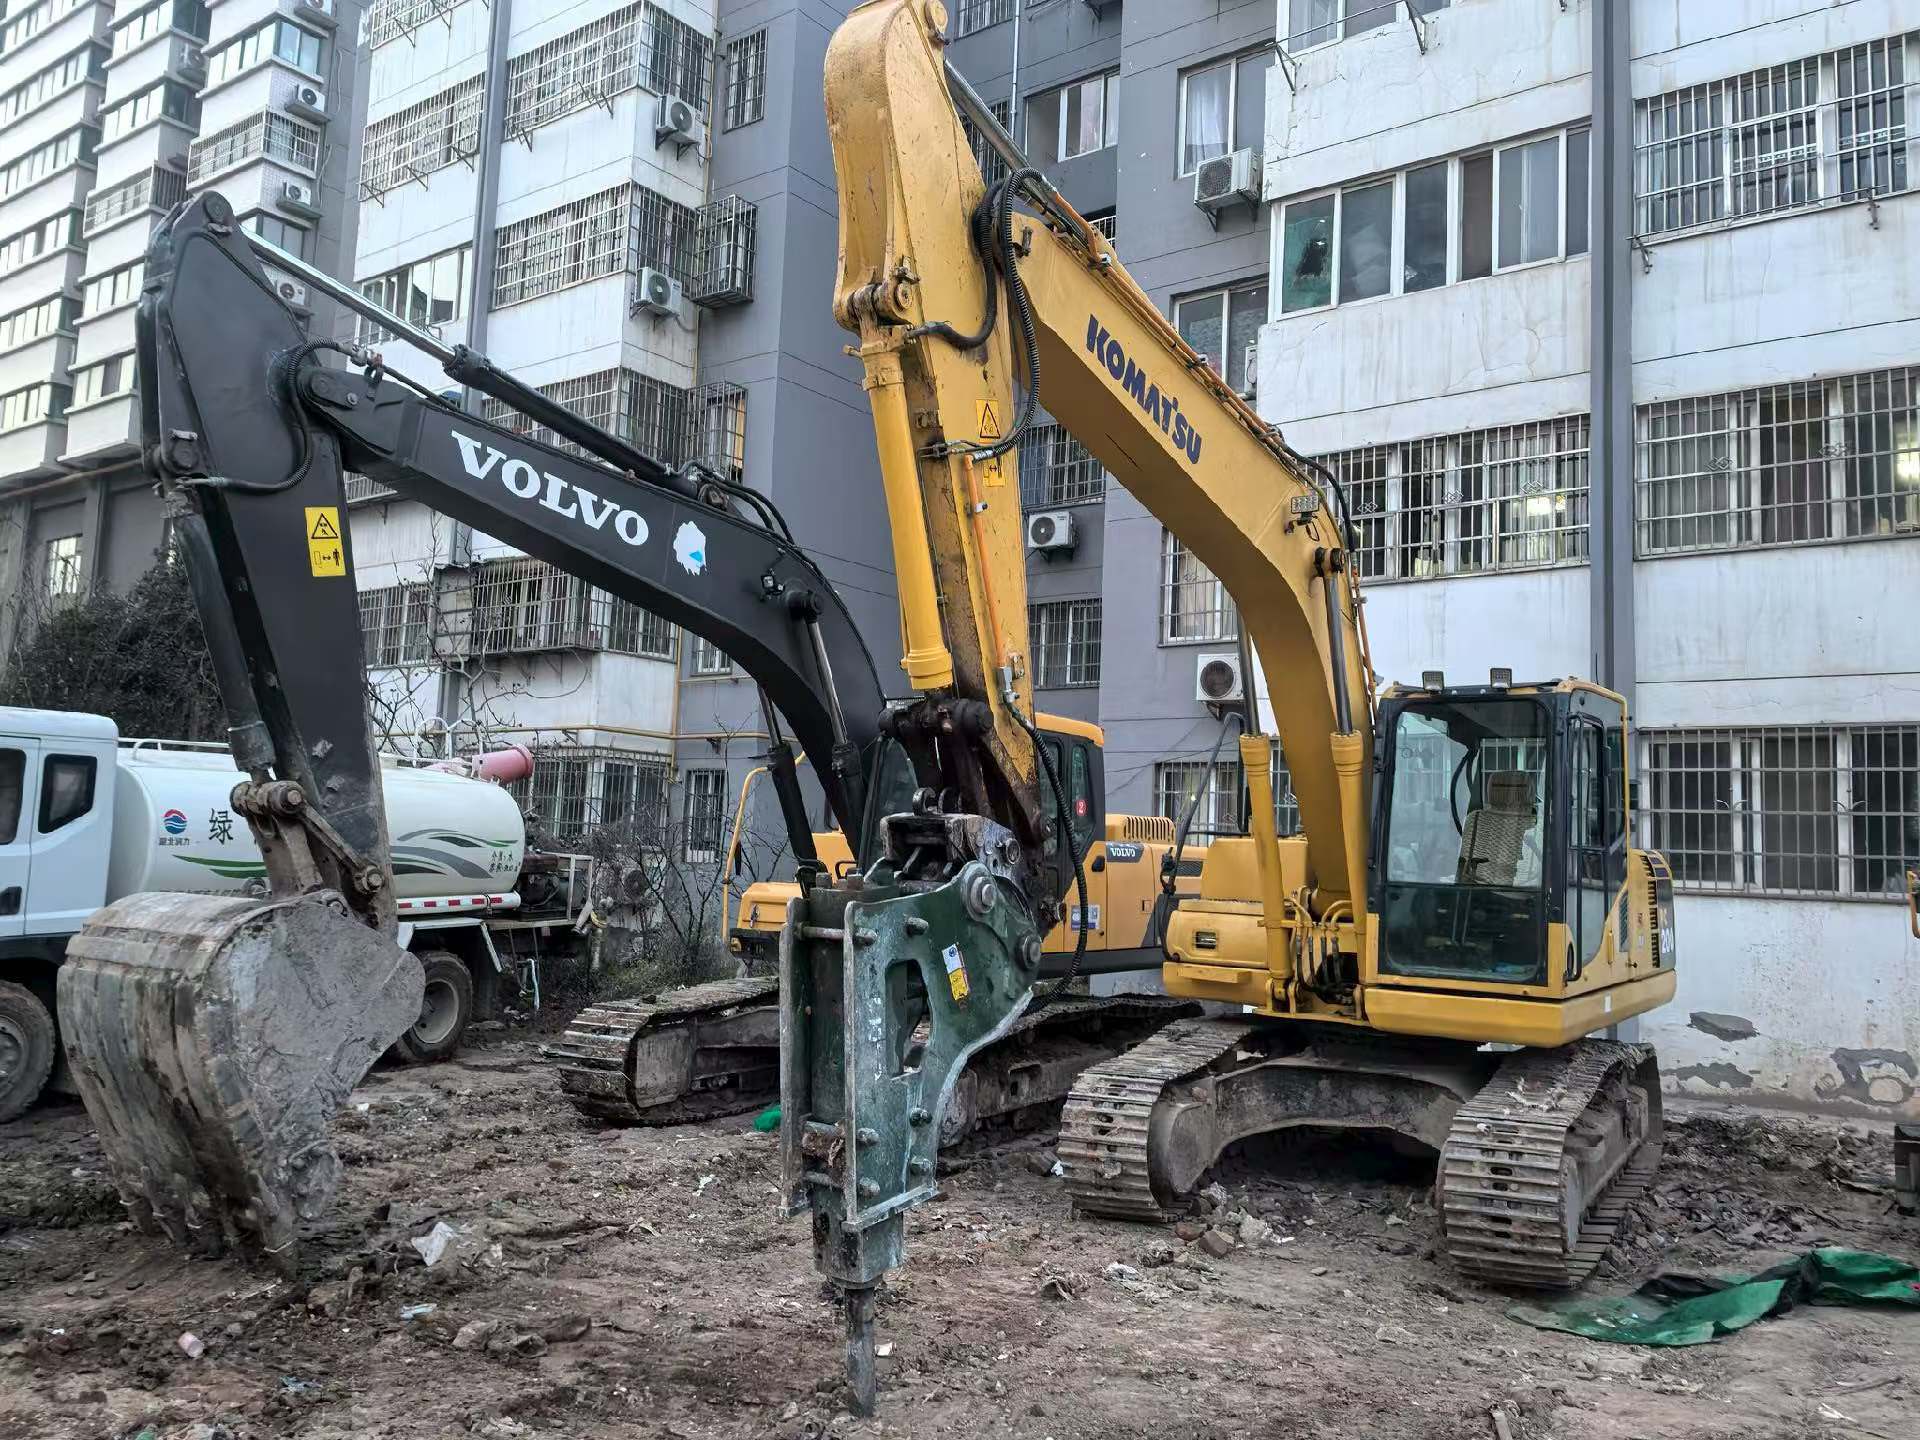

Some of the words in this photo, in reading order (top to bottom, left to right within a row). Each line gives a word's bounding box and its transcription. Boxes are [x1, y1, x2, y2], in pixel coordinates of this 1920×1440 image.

[1086, 313, 1202, 465] KOMATSU
[450, 430, 650, 546] VOLVO
[208, 807, 234, 845] 绿
[1110, 847, 1136, 857] VOLVO
